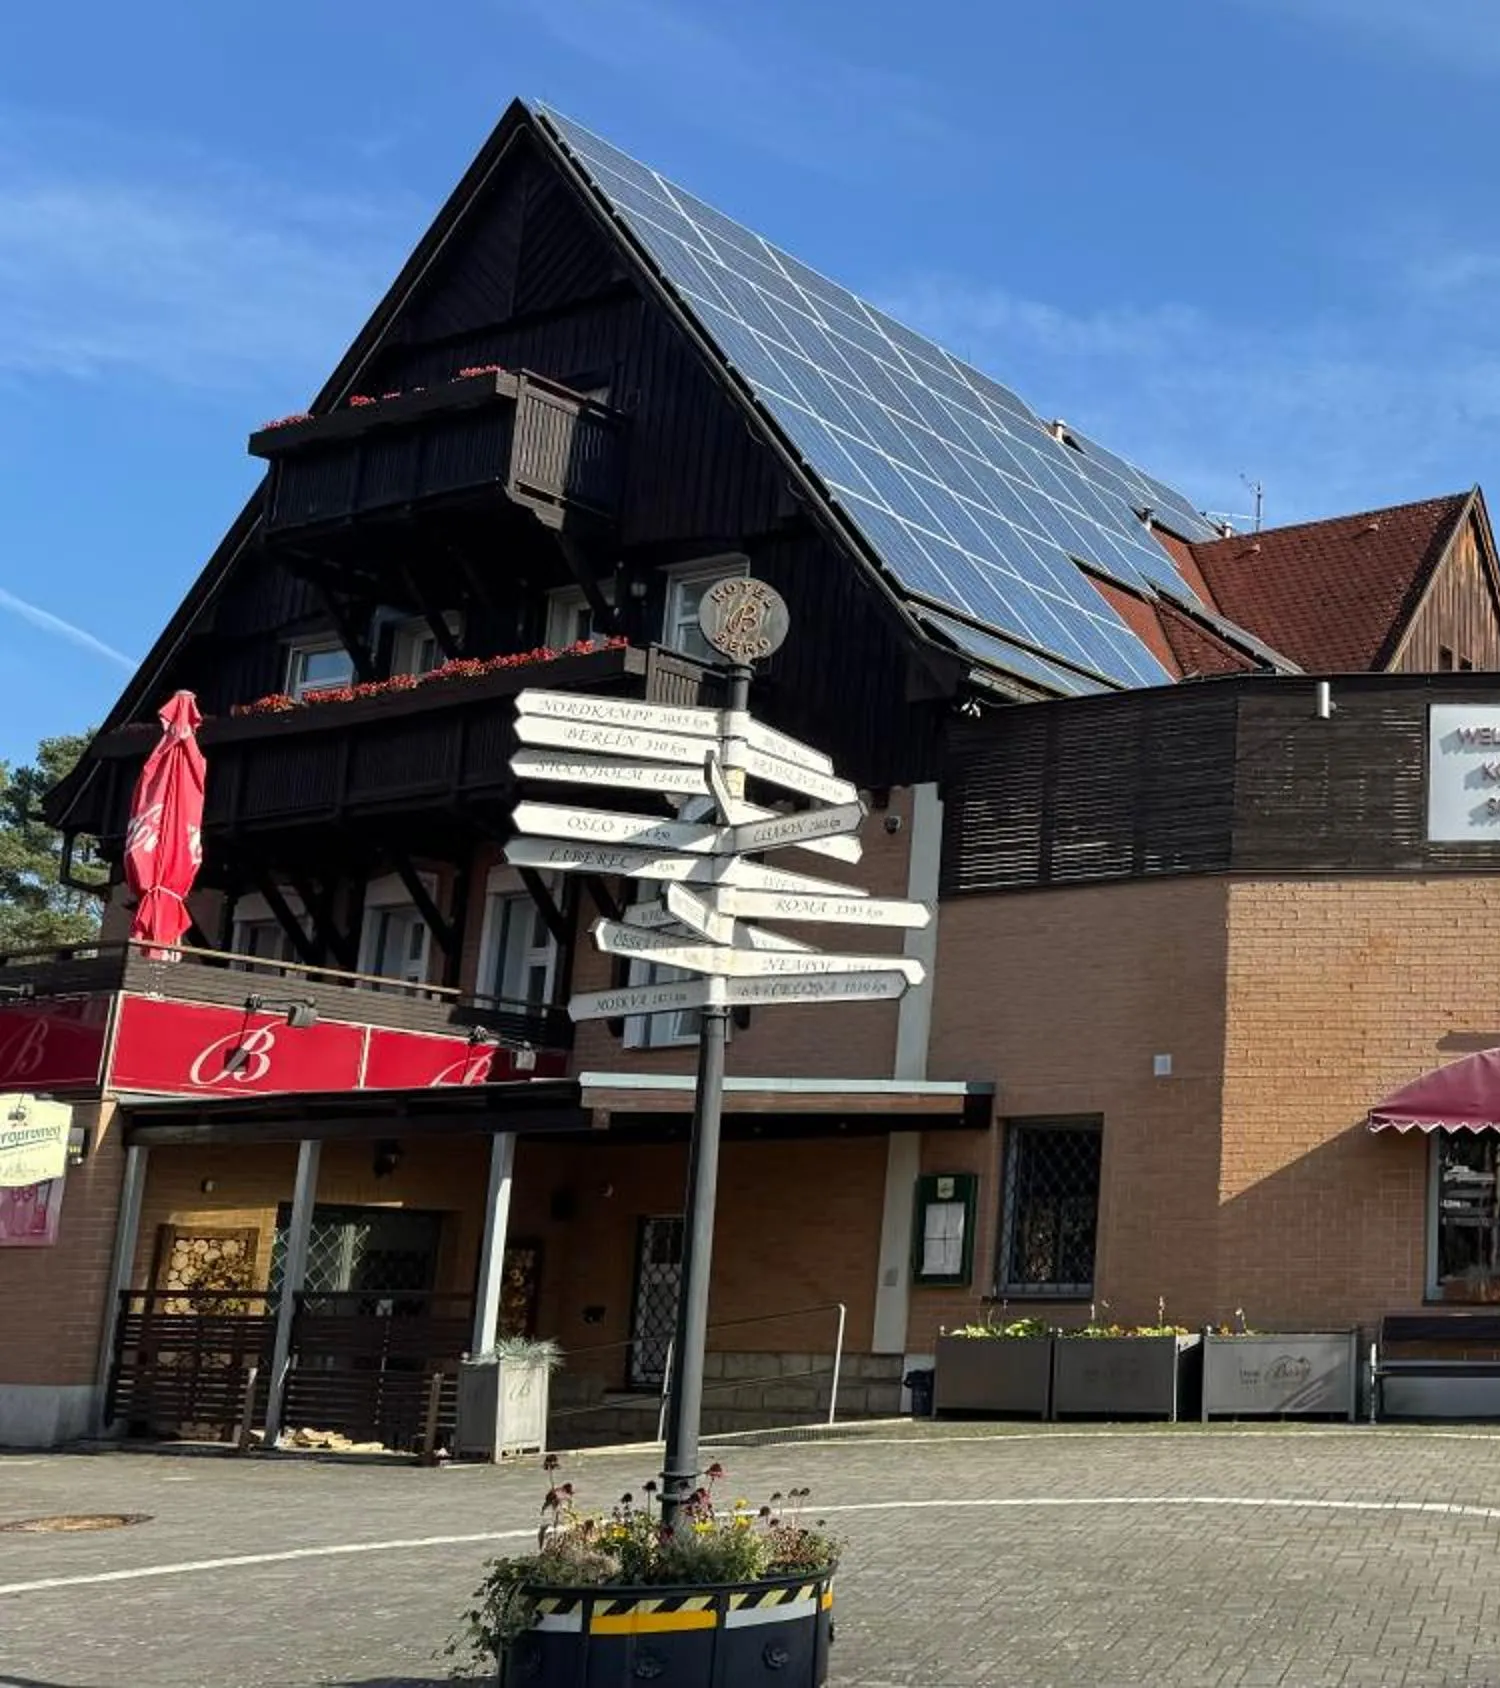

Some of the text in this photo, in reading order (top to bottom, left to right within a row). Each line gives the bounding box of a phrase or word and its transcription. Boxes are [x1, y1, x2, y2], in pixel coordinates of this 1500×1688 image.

[564, 728, 639, 748] BERLIN
[535, 758, 644, 781] STOCKHOLM
[567, 816, 615, 833] OSLO
[549, 848, 632, 870] LIBEREC
[776, 900, 828, 915] ROMA
[190, 1021, 284, 1085] B
